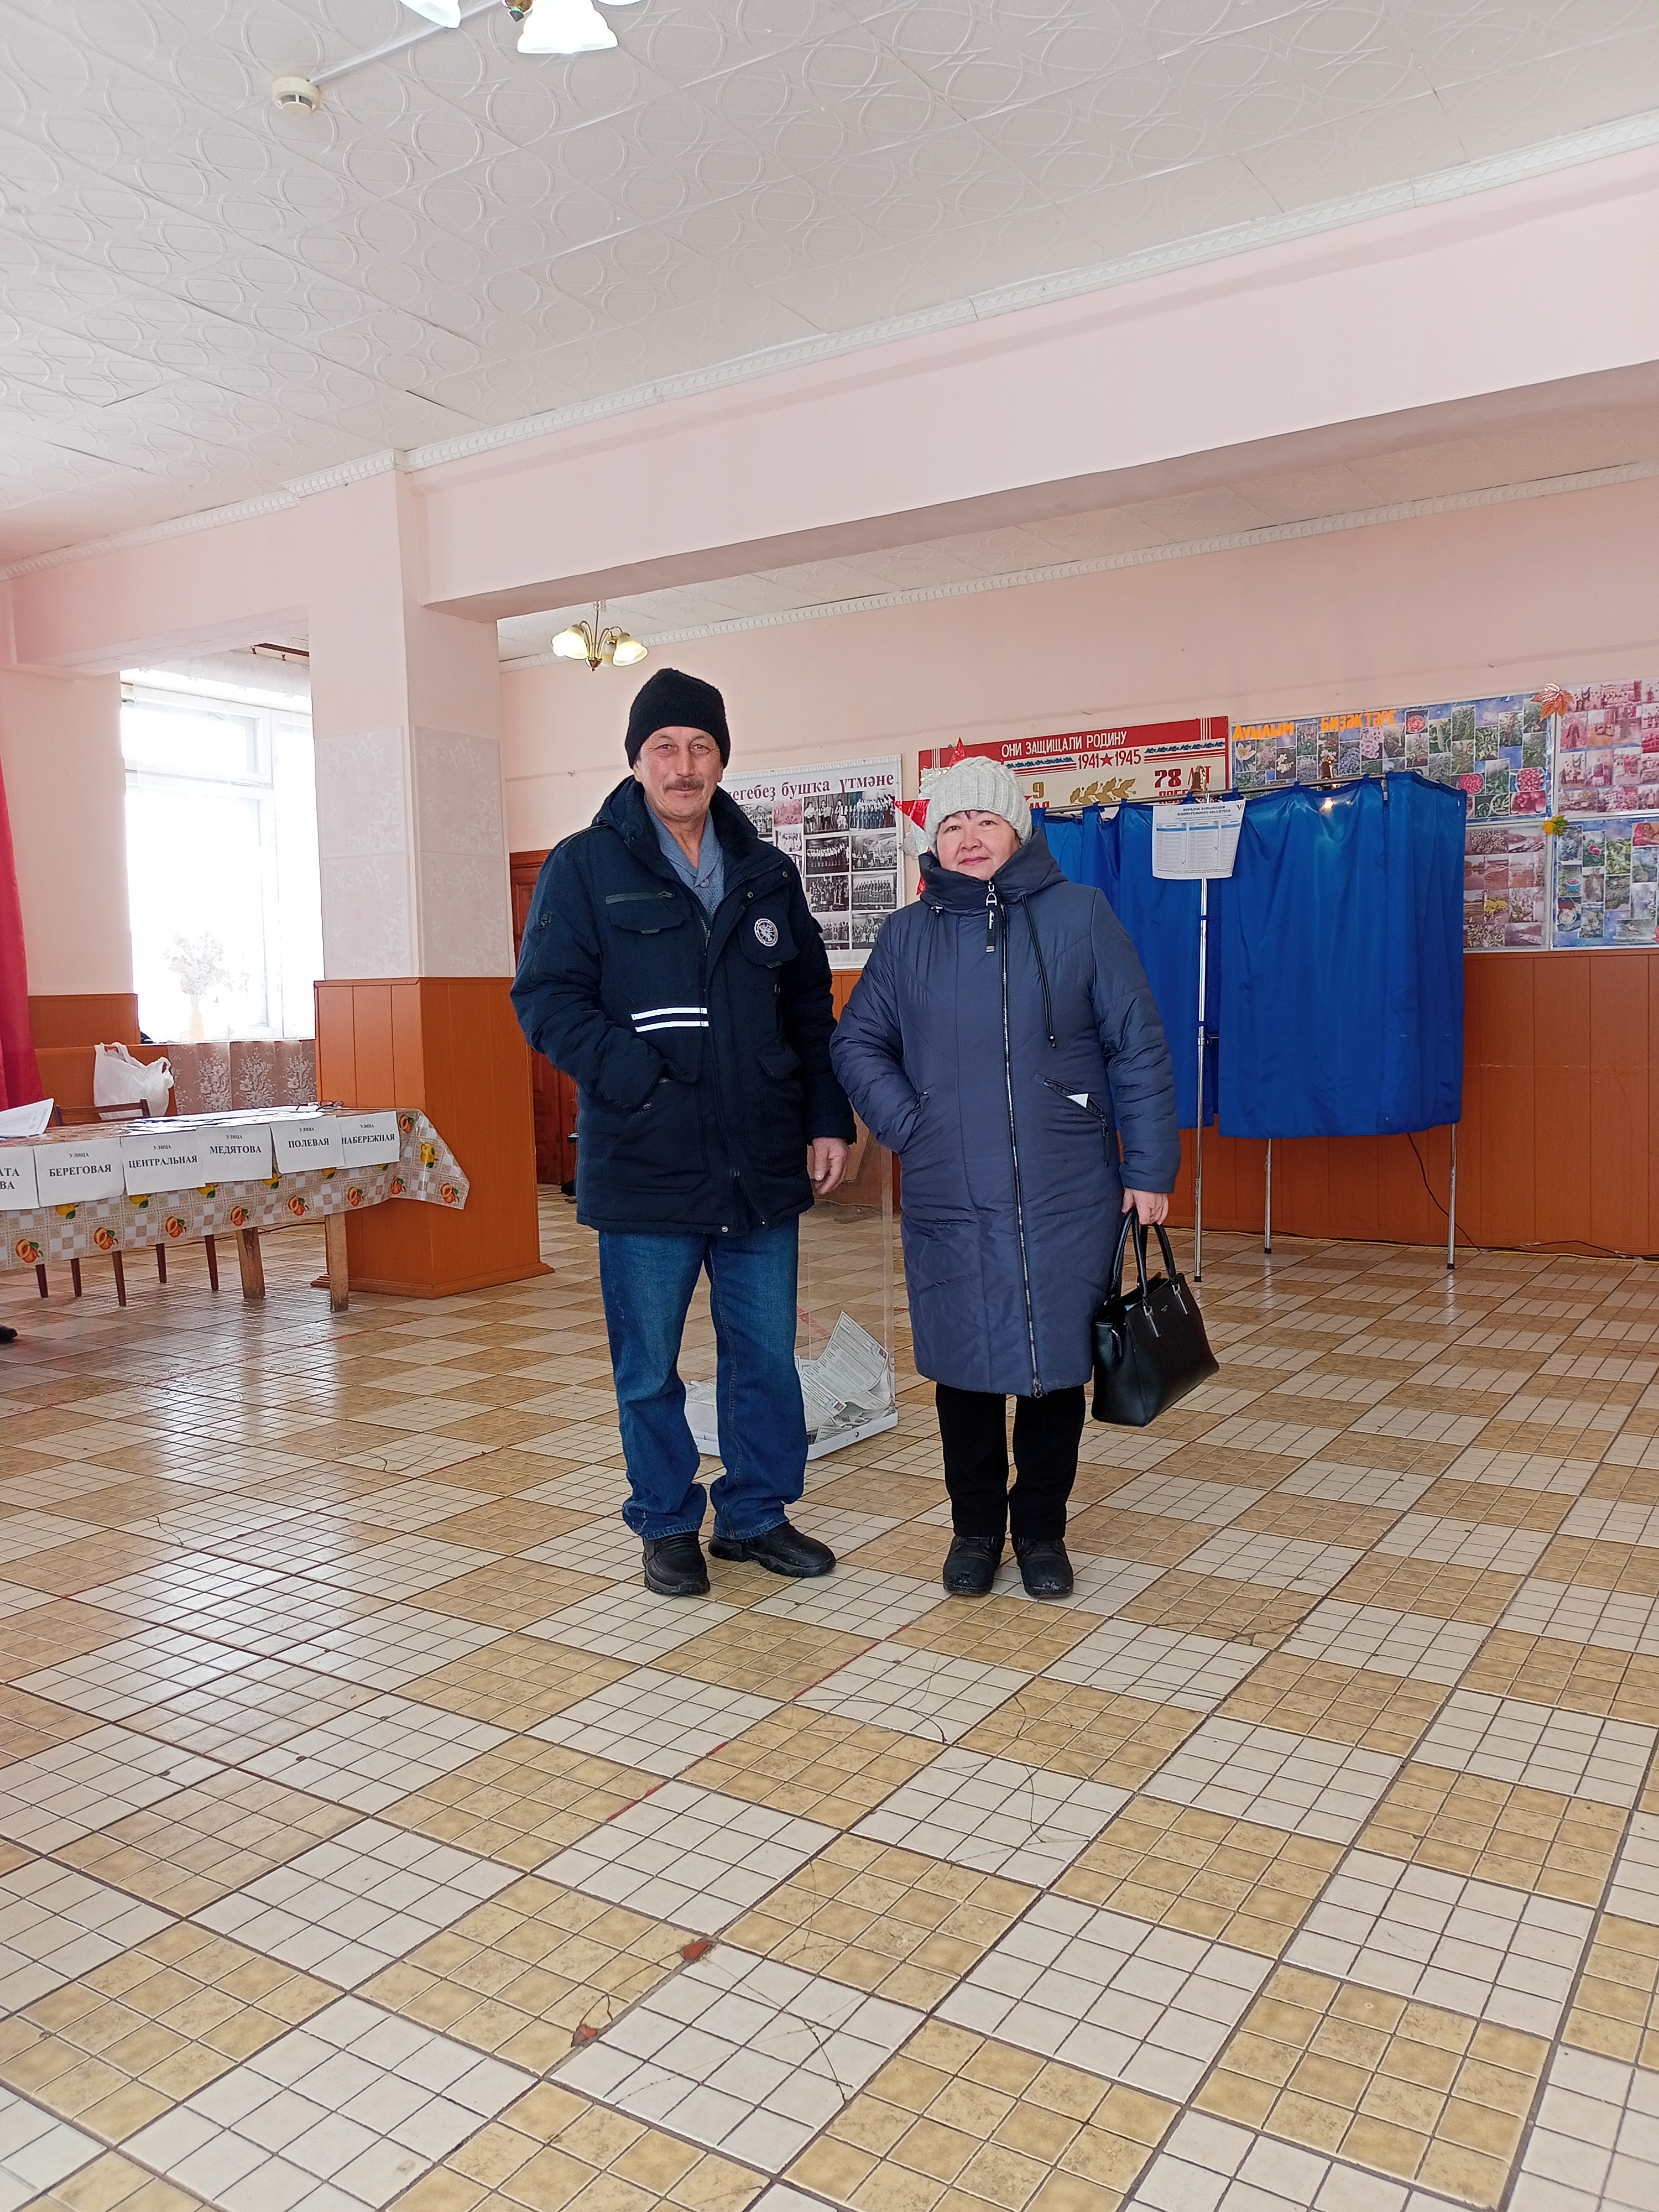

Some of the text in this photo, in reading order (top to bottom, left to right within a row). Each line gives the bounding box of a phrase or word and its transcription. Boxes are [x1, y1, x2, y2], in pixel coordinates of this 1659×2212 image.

[1001, 731, 1127, 758] ОНИ ЗАЩИЩАЛИ РОДИНУ
[1155, 768, 1182, 789] 78
[1032, 781, 1044, 799] 9
[288, 1138, 330, 1149] ПОЛЕВАЯ
[341, 1134, 395, 1145] НАБЕРЕЖНАЯ
[210, 1146, 262, 1155] МЕДЯТОВА
[128, 1155, 198, 1168] ЦЕНТРАЛЬНАЯ
[49, 1164, 112, 1177] БЕРЕГОВАЯ
